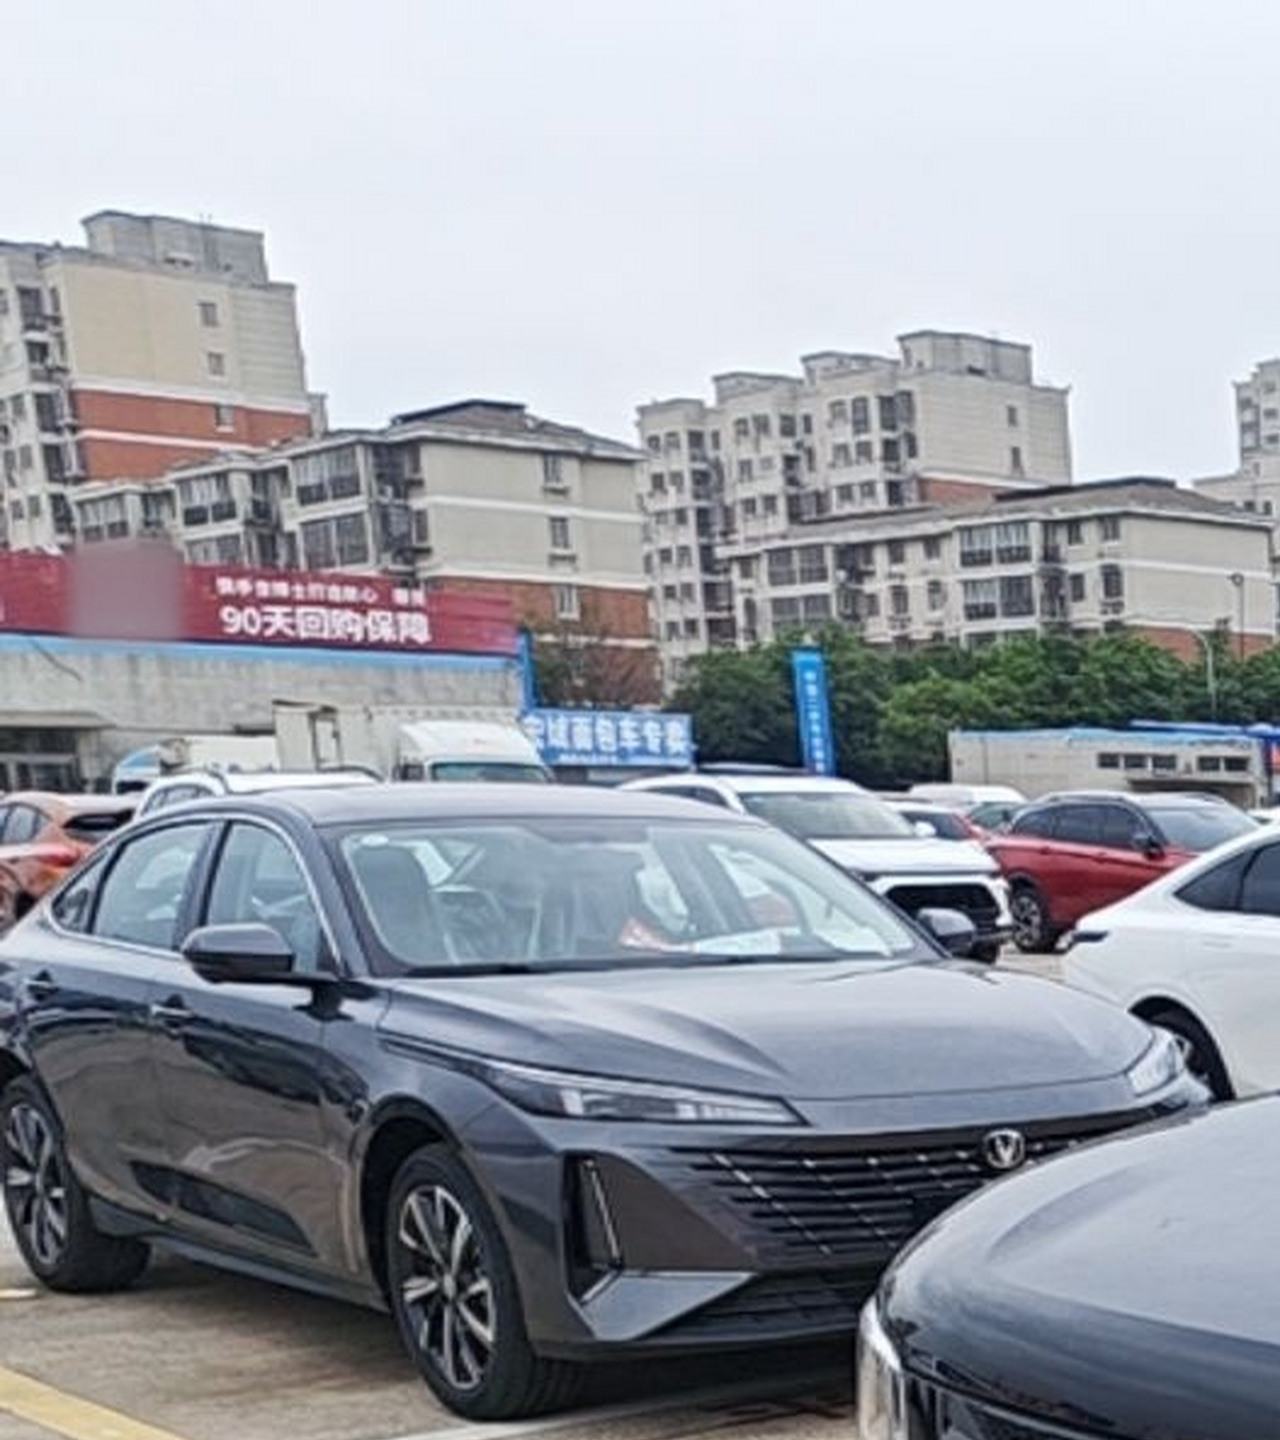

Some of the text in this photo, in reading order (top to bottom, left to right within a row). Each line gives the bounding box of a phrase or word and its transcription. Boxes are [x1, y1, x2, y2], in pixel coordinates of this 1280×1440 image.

[219, 605, 431, 643] 90天回购保障
